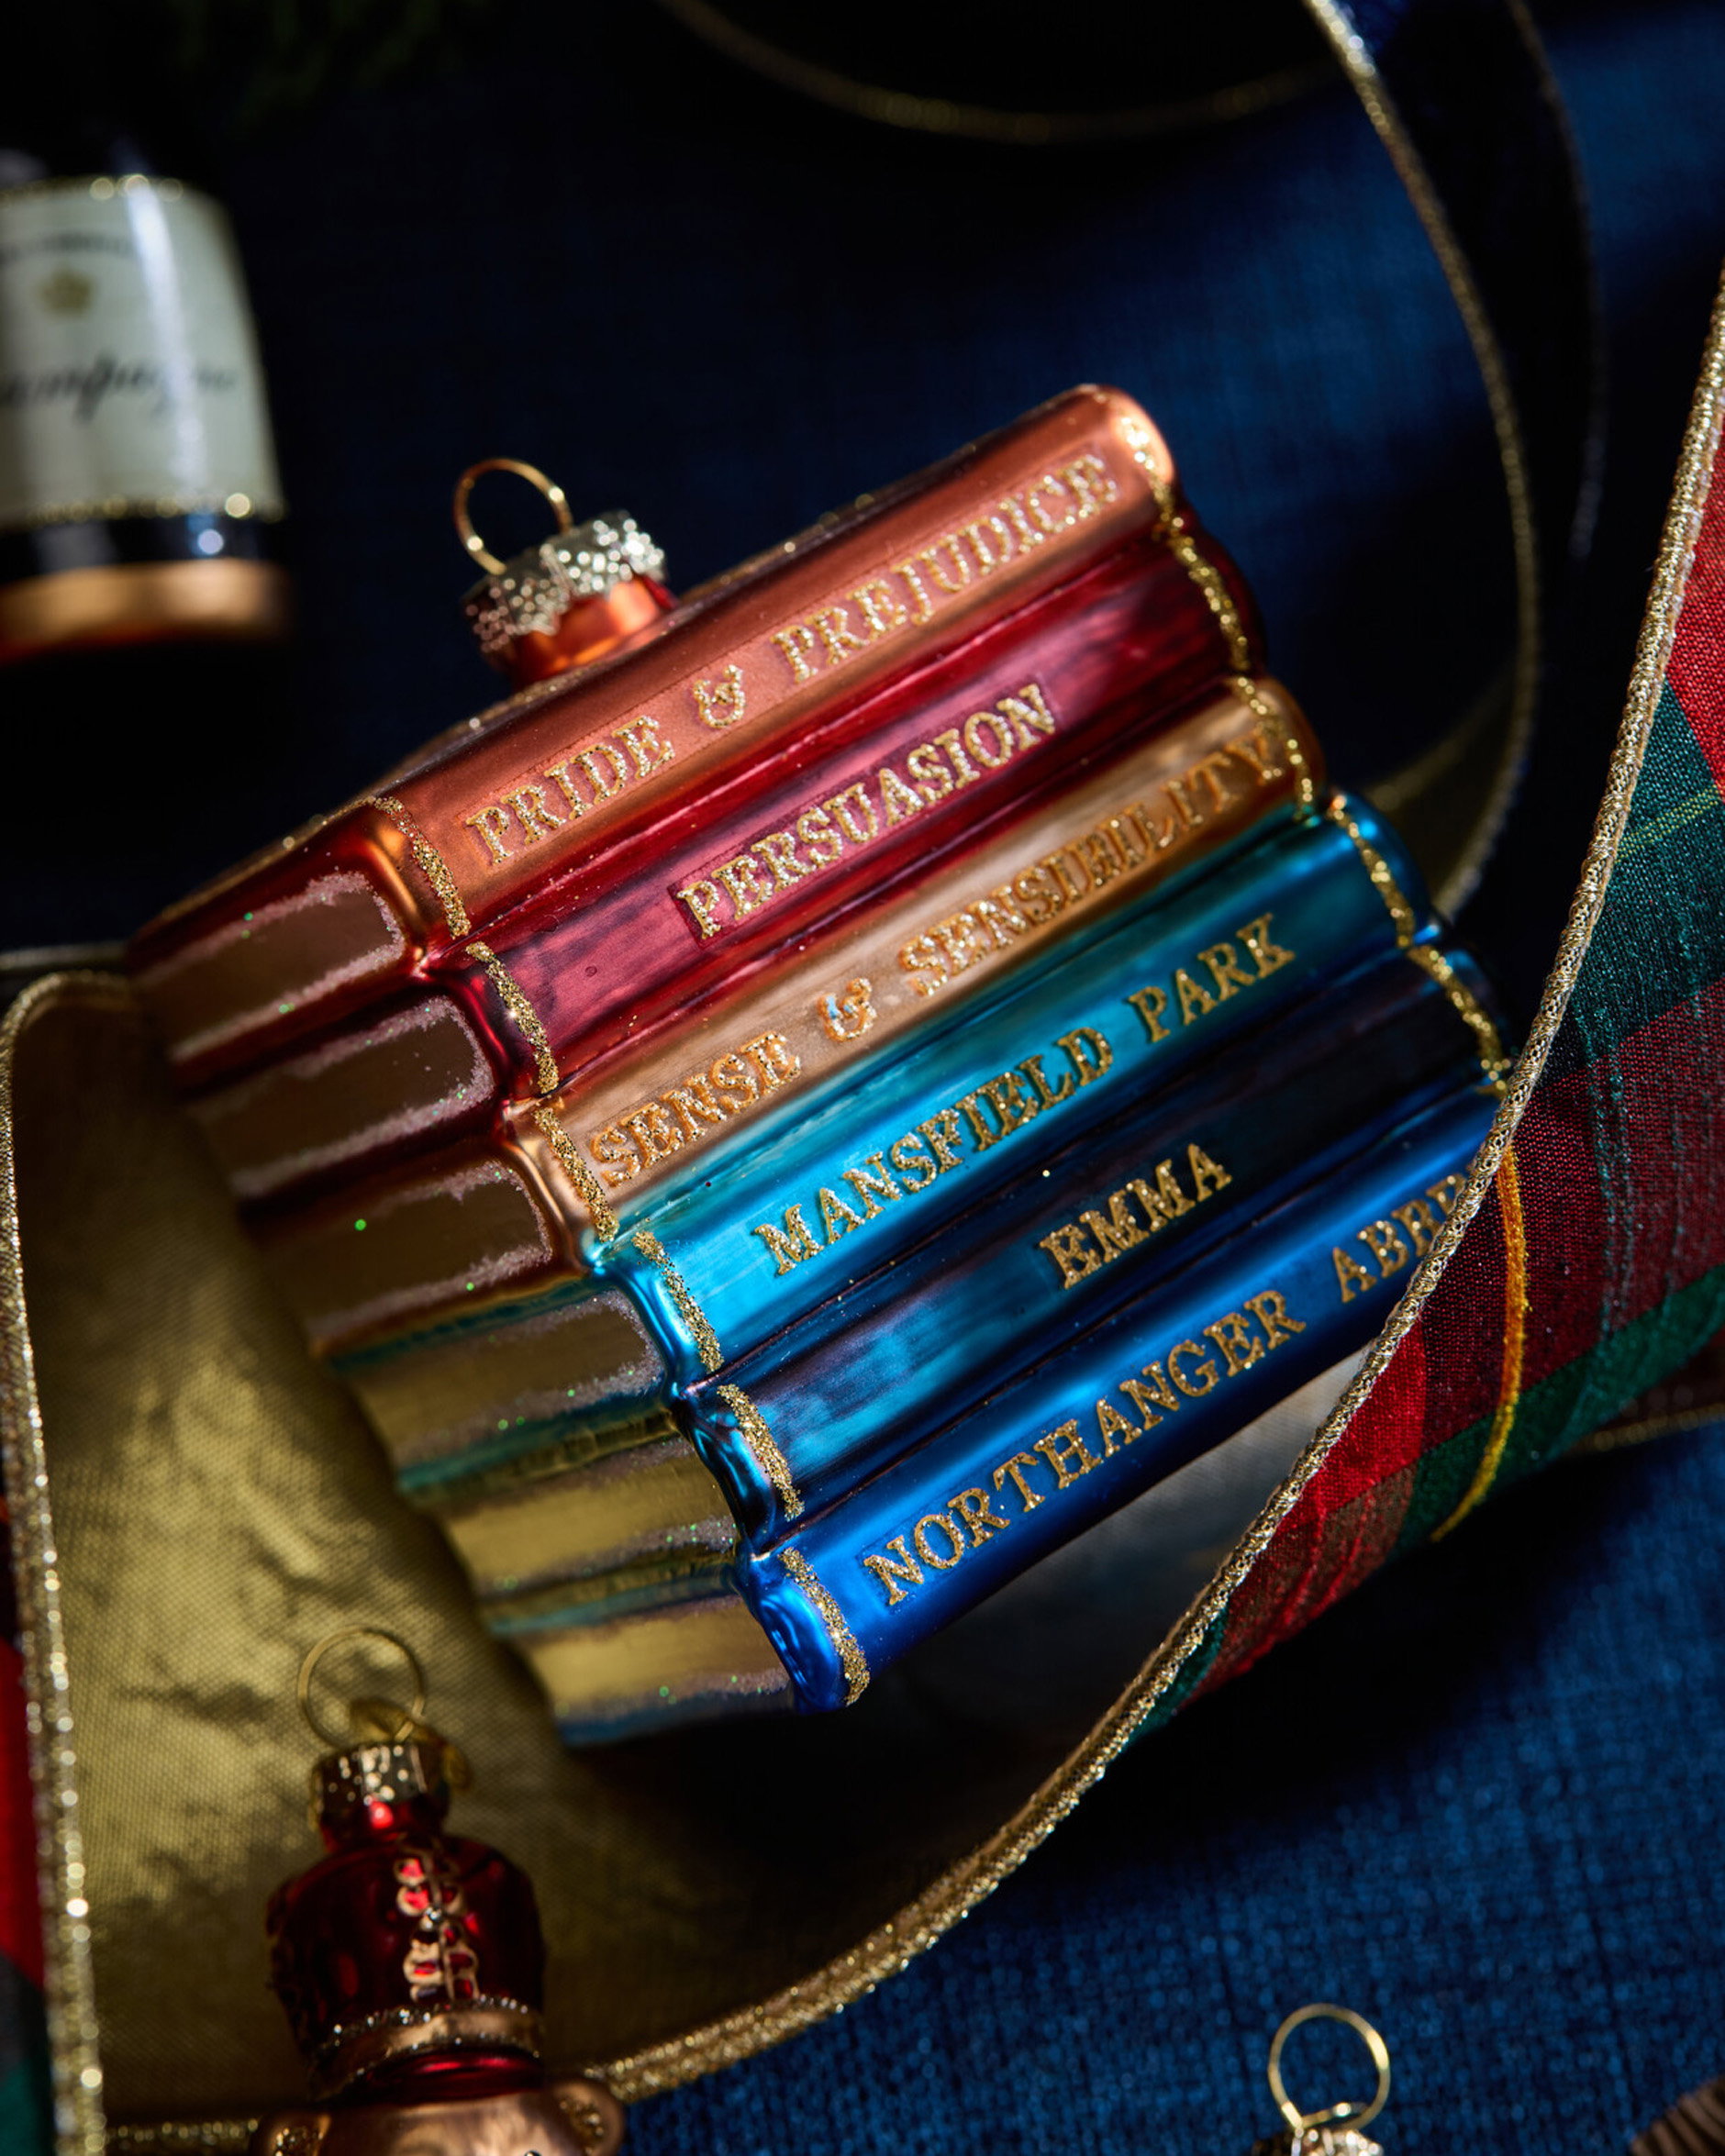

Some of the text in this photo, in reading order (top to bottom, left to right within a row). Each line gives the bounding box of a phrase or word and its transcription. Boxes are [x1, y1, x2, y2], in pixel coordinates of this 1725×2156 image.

[465, 453, 1116, 865] PRIDE & PREJUDICE
[677, 683, 1056, 939] PERSUASION
[590, 732, 1283, 1187] SENSE & SENSIBILITY
[752, 913, 1295, 1275] MANSFIELD PARK
[1039, 1143, 1231, 1290] EMMA
[863, 1289, 1306, 1605] NORTHANGER
